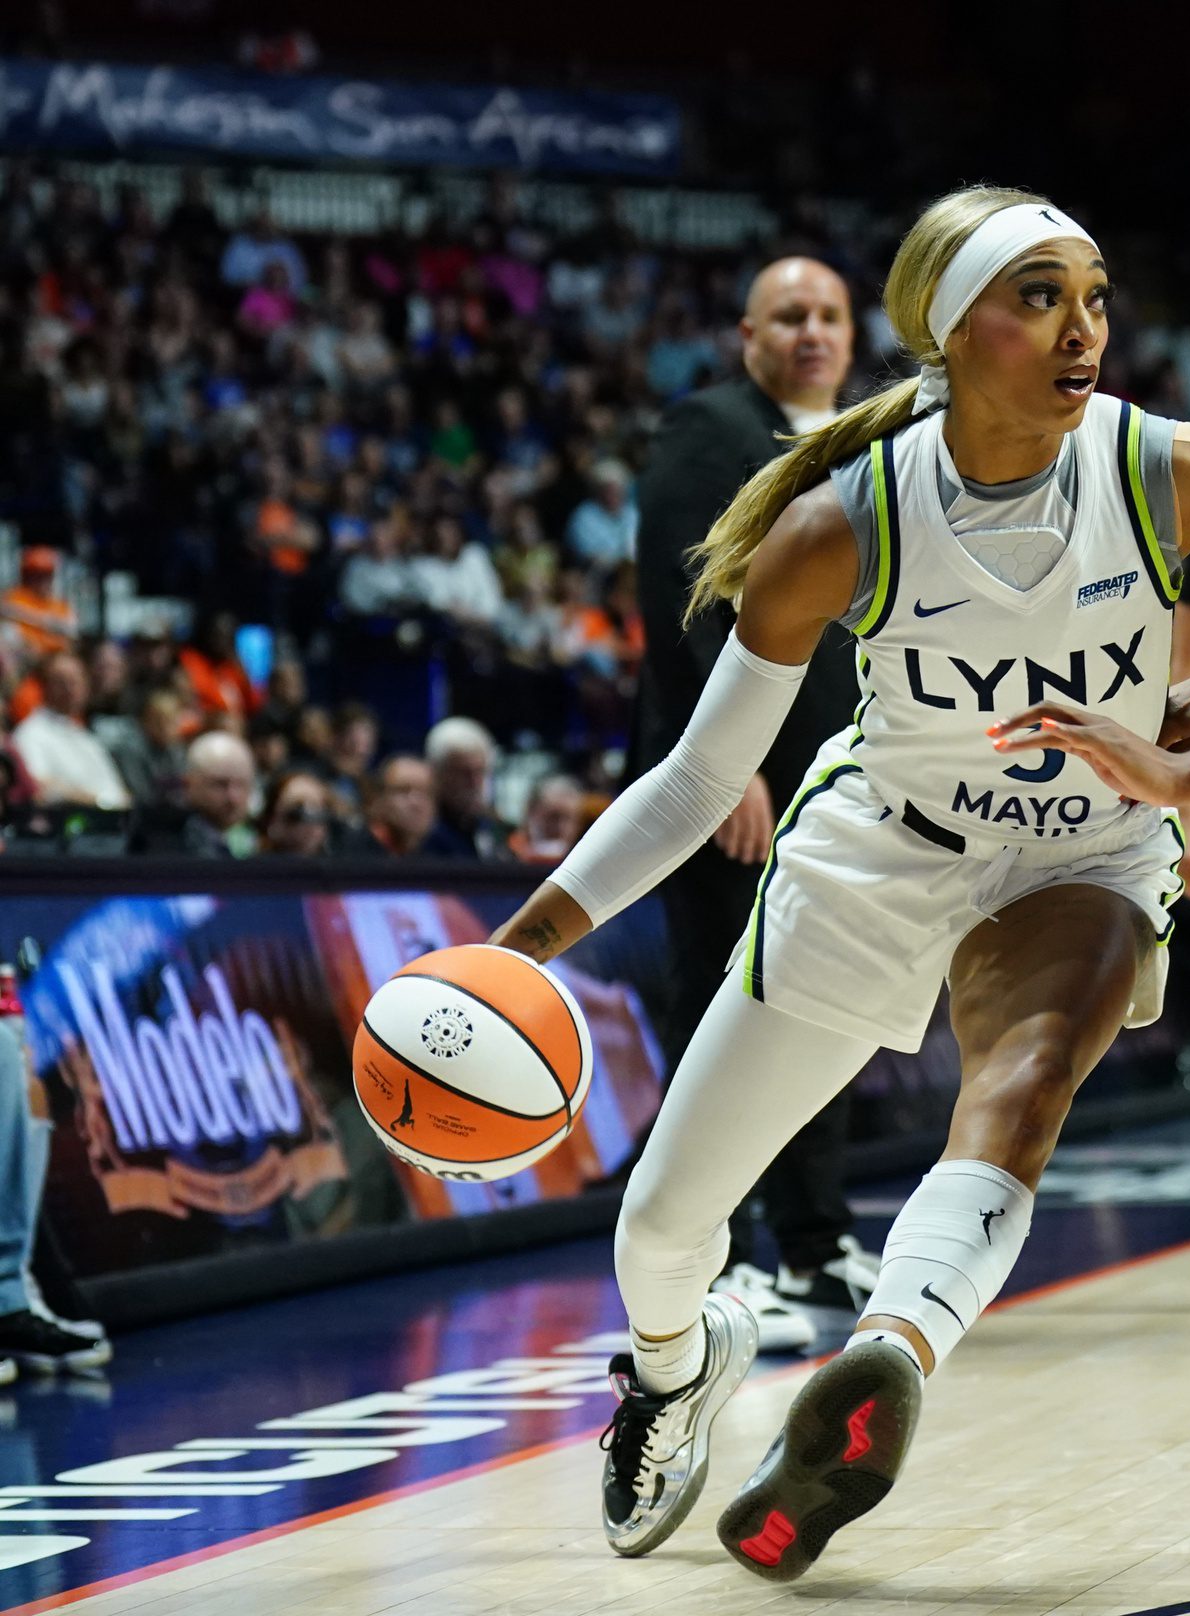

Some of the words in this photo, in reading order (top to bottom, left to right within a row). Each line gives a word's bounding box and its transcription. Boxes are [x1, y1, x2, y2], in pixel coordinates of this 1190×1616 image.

[1077, 588, 1120, 608] INSURANCE
[1078, 571, 1138, 600] FEDERATED
[904, 625, 1146, 712] LYNX
[952, 781, 1091, 827] MAYO
[53, 961, 301, 1151] Modelo
